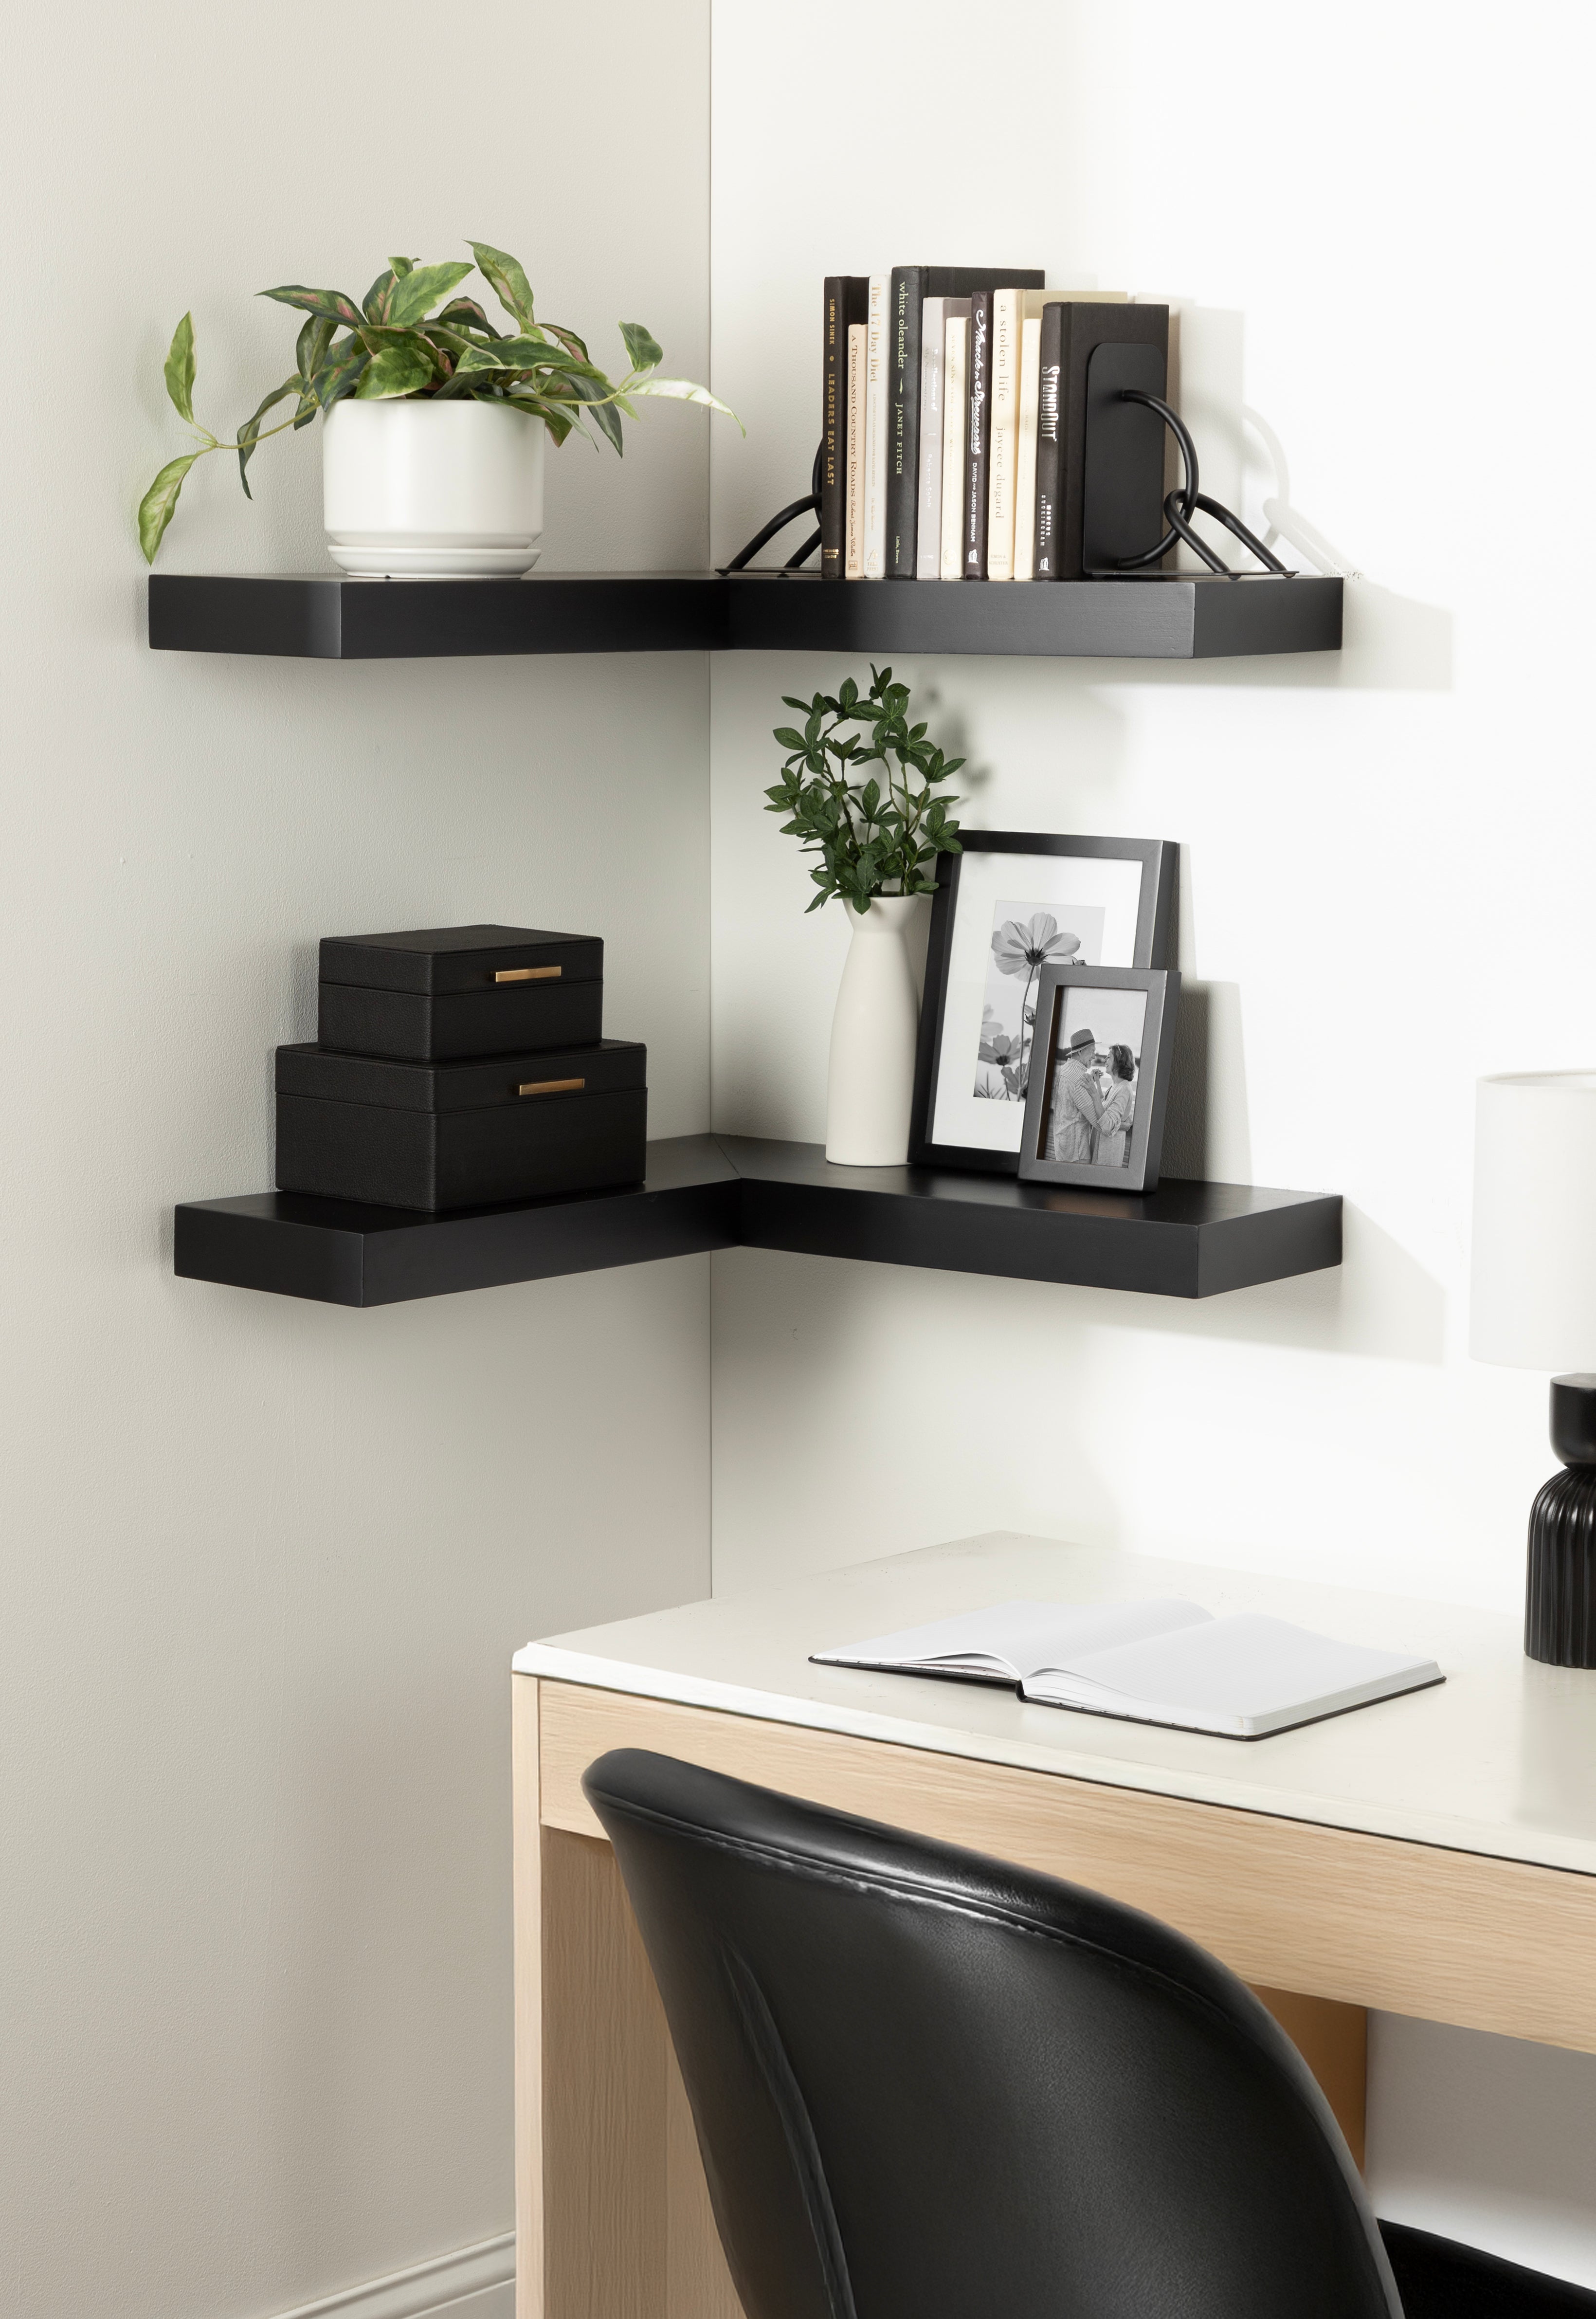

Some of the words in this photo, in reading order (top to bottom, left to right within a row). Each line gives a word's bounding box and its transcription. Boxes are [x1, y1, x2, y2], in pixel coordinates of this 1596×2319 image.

[871, 284, 882, 307] The
[898, 281, 908, 316] white
[871, 311, 881, 326] 17
[869, 331, 881, 354] Day
[897, 319, 908, 369] oleander
[999, 320, 1010, 367] stolen
[870, 358, 881, 383] Diet
[998, 375, 1009, 402] life
[895, 402, 904, 437] JANET
[930, 402, 938, 412] of
[995, 426, 1006, 468] jaycee
[994, 474, 1006, 519] dugard
